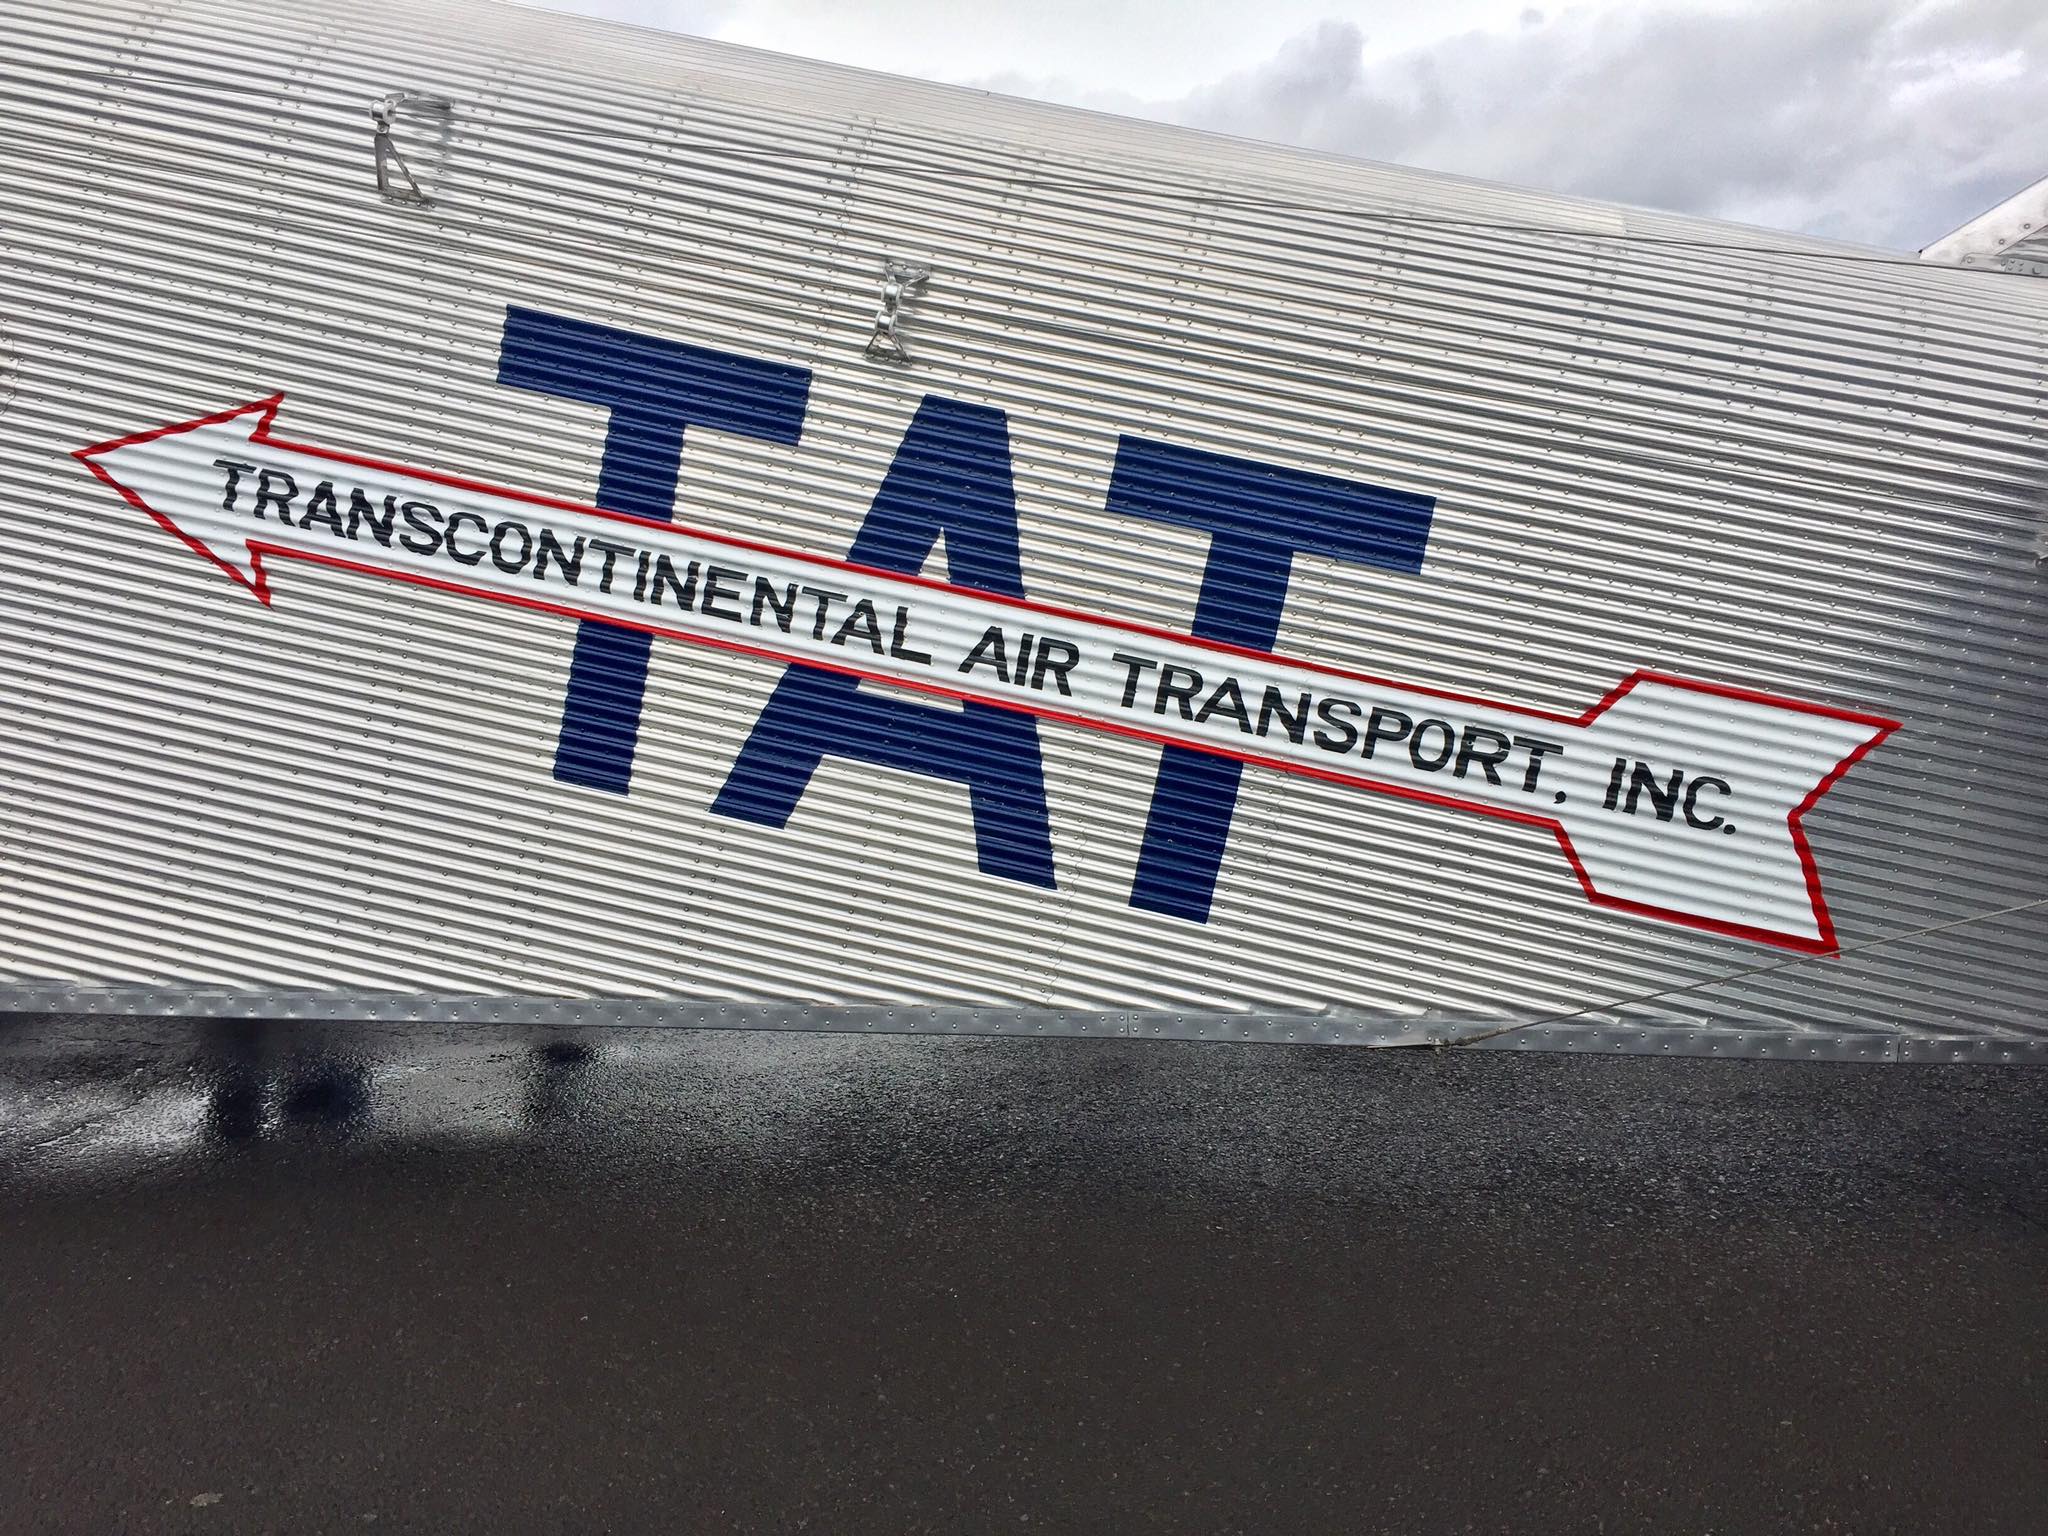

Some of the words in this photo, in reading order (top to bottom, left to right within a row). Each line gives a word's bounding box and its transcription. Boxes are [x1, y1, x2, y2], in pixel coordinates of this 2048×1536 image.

[213, 458, 932, 666] TRANSCONTINENTAL
[957, 625, 1081, 698] AIR
[1111, 652, 1567, 805] TRANSPORT,
[1601, 757, 1738, 836] INC.
[497, 304, 1437, 925] TAT
